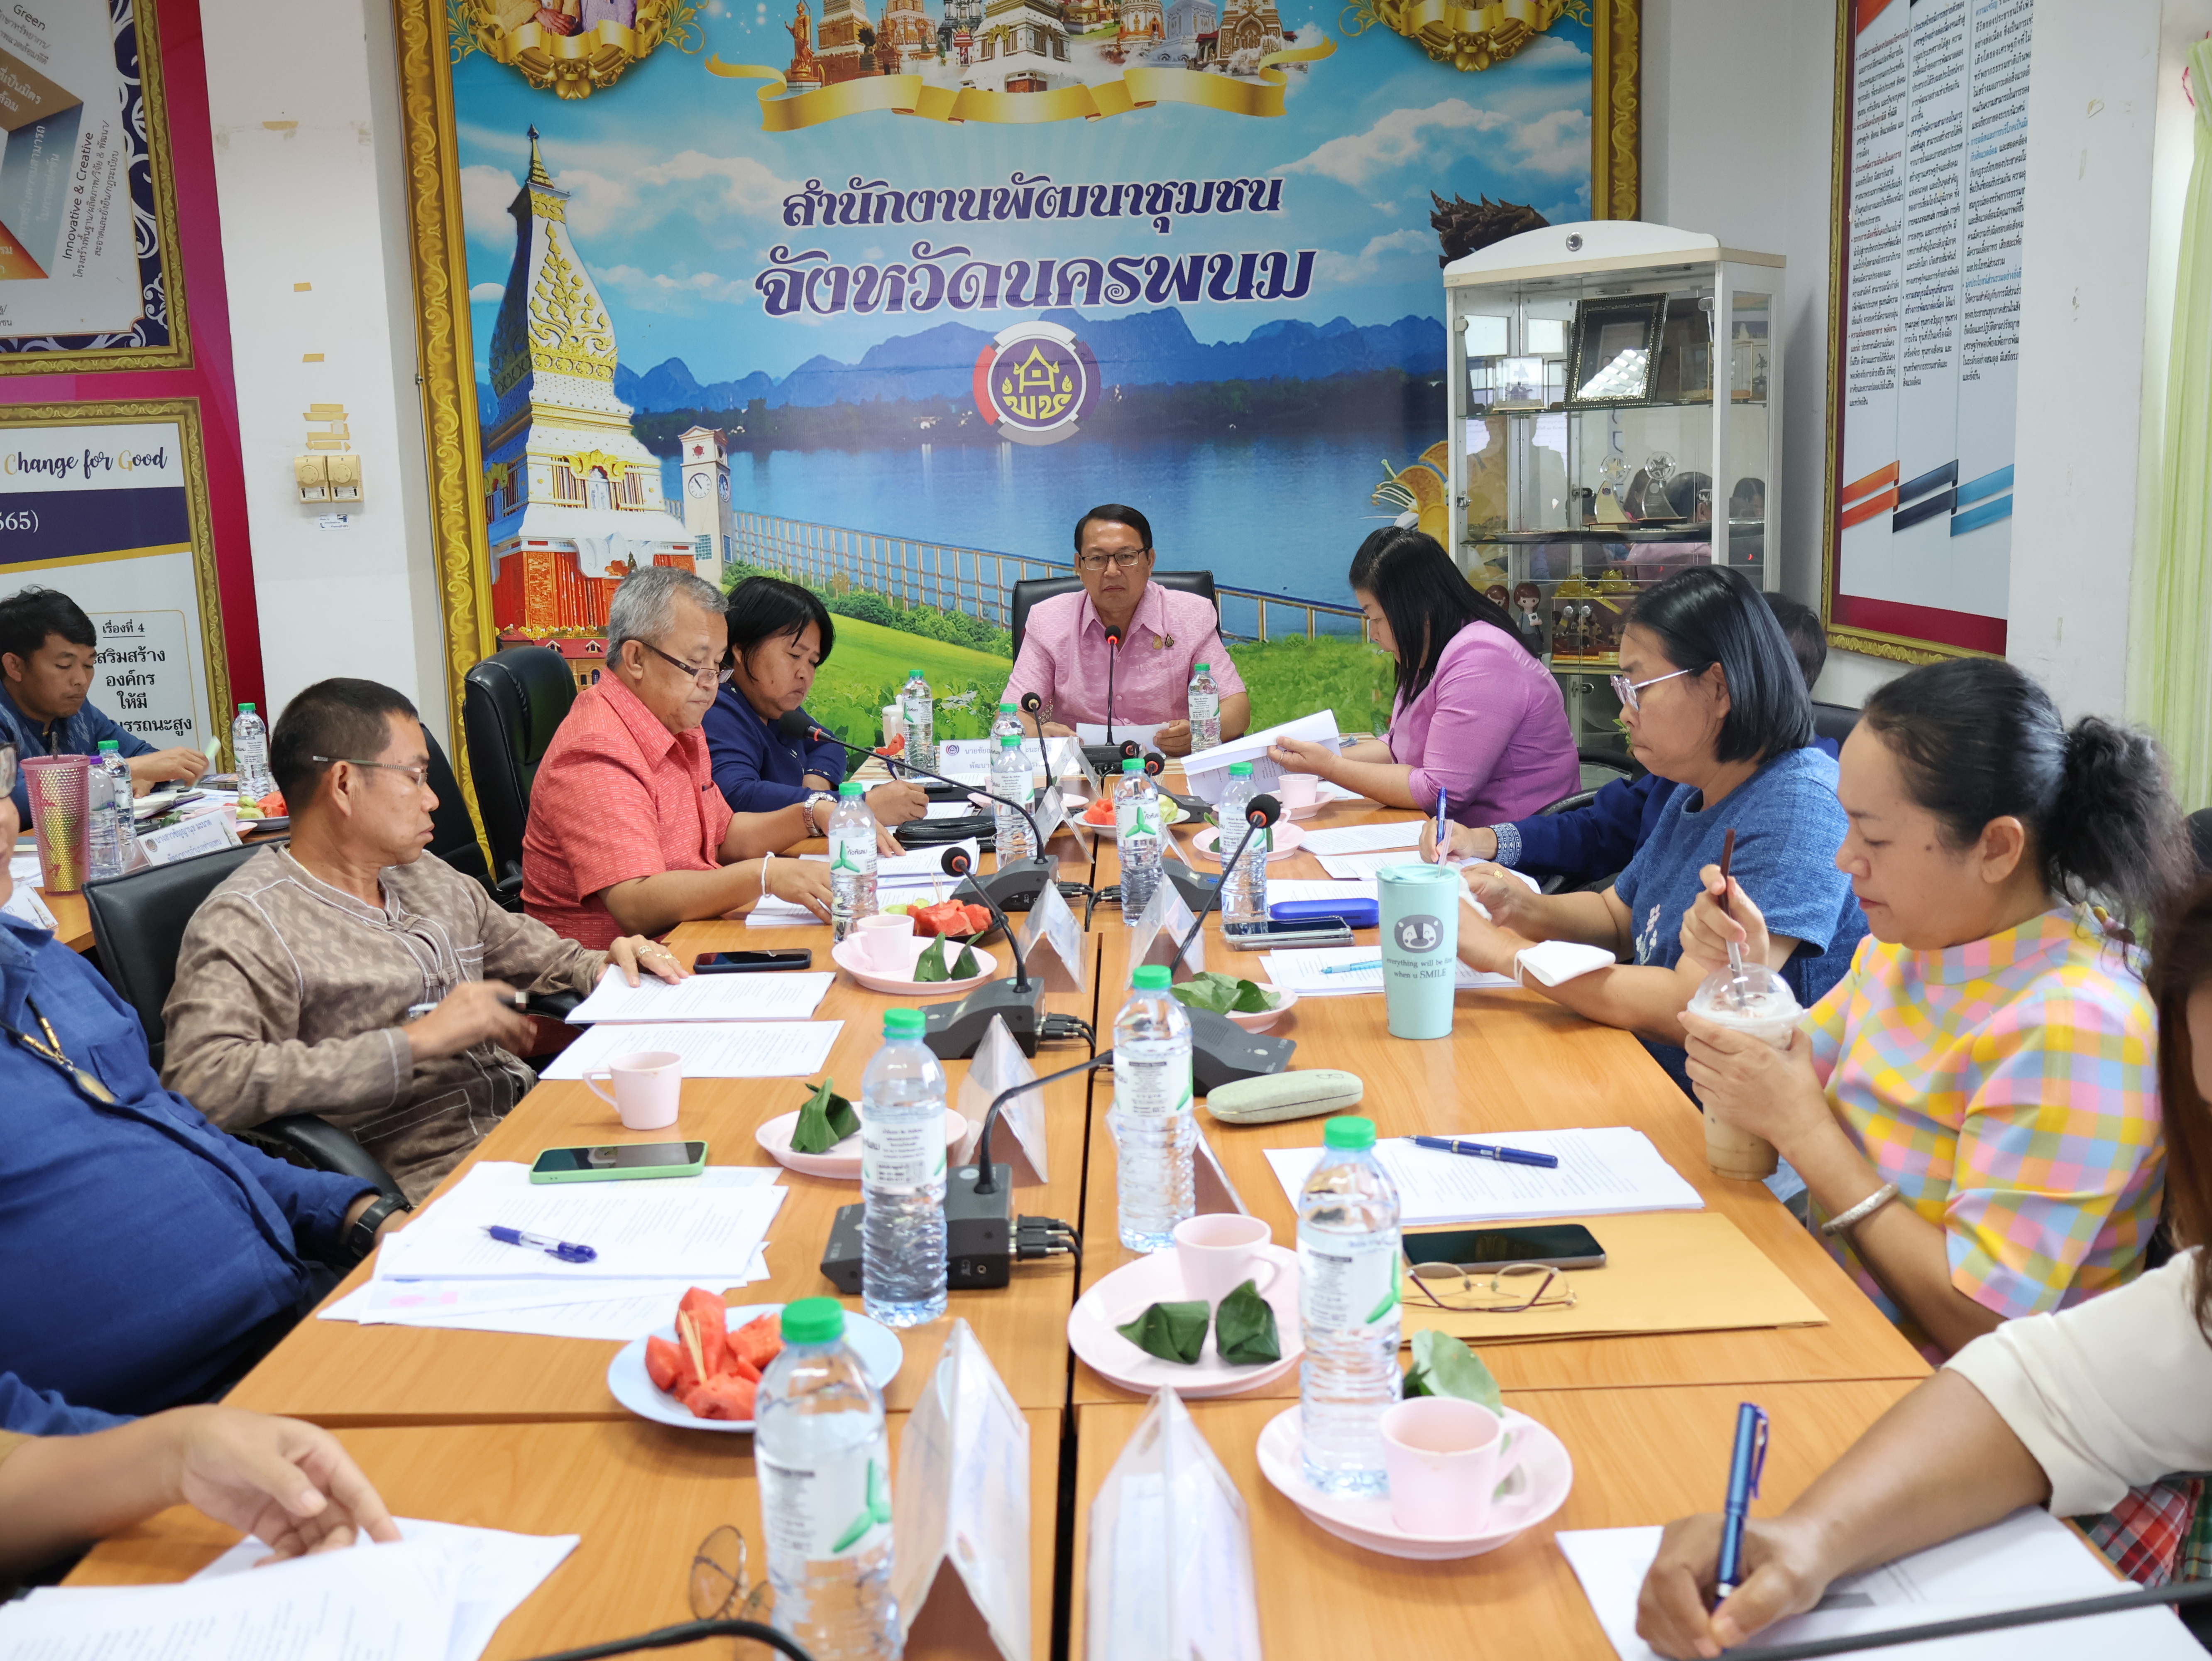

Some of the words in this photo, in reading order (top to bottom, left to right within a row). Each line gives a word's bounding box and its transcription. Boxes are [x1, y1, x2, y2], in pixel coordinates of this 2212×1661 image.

[14, 4, 46, 31] Green
[76, 132, 93, 181] Creative
[74, 186, 83, 194] &
[782, 170, 1283, 234] สำนักงานพัฒนาชุมชน
[62, 198, 82, 260] Innovative
[754, 240, 1317, 316] จังหวัดนครพนม
[4, 451, 78, 478] Change
[84, 449, 113, 479] for
[118, 447, 167, 471] Good
[103, 619, 133, 633] เรื่องที่
[137, 623, 145, 632] 4
[106, 669, 155, 686] องค์กร
[116, 691, 147, 709] ให้มี
[120, 719, 191, 736] รรถนะสูง
[1387, 958, 1418, 968] everything
[1420, 968, 1446, 979] SMILE
